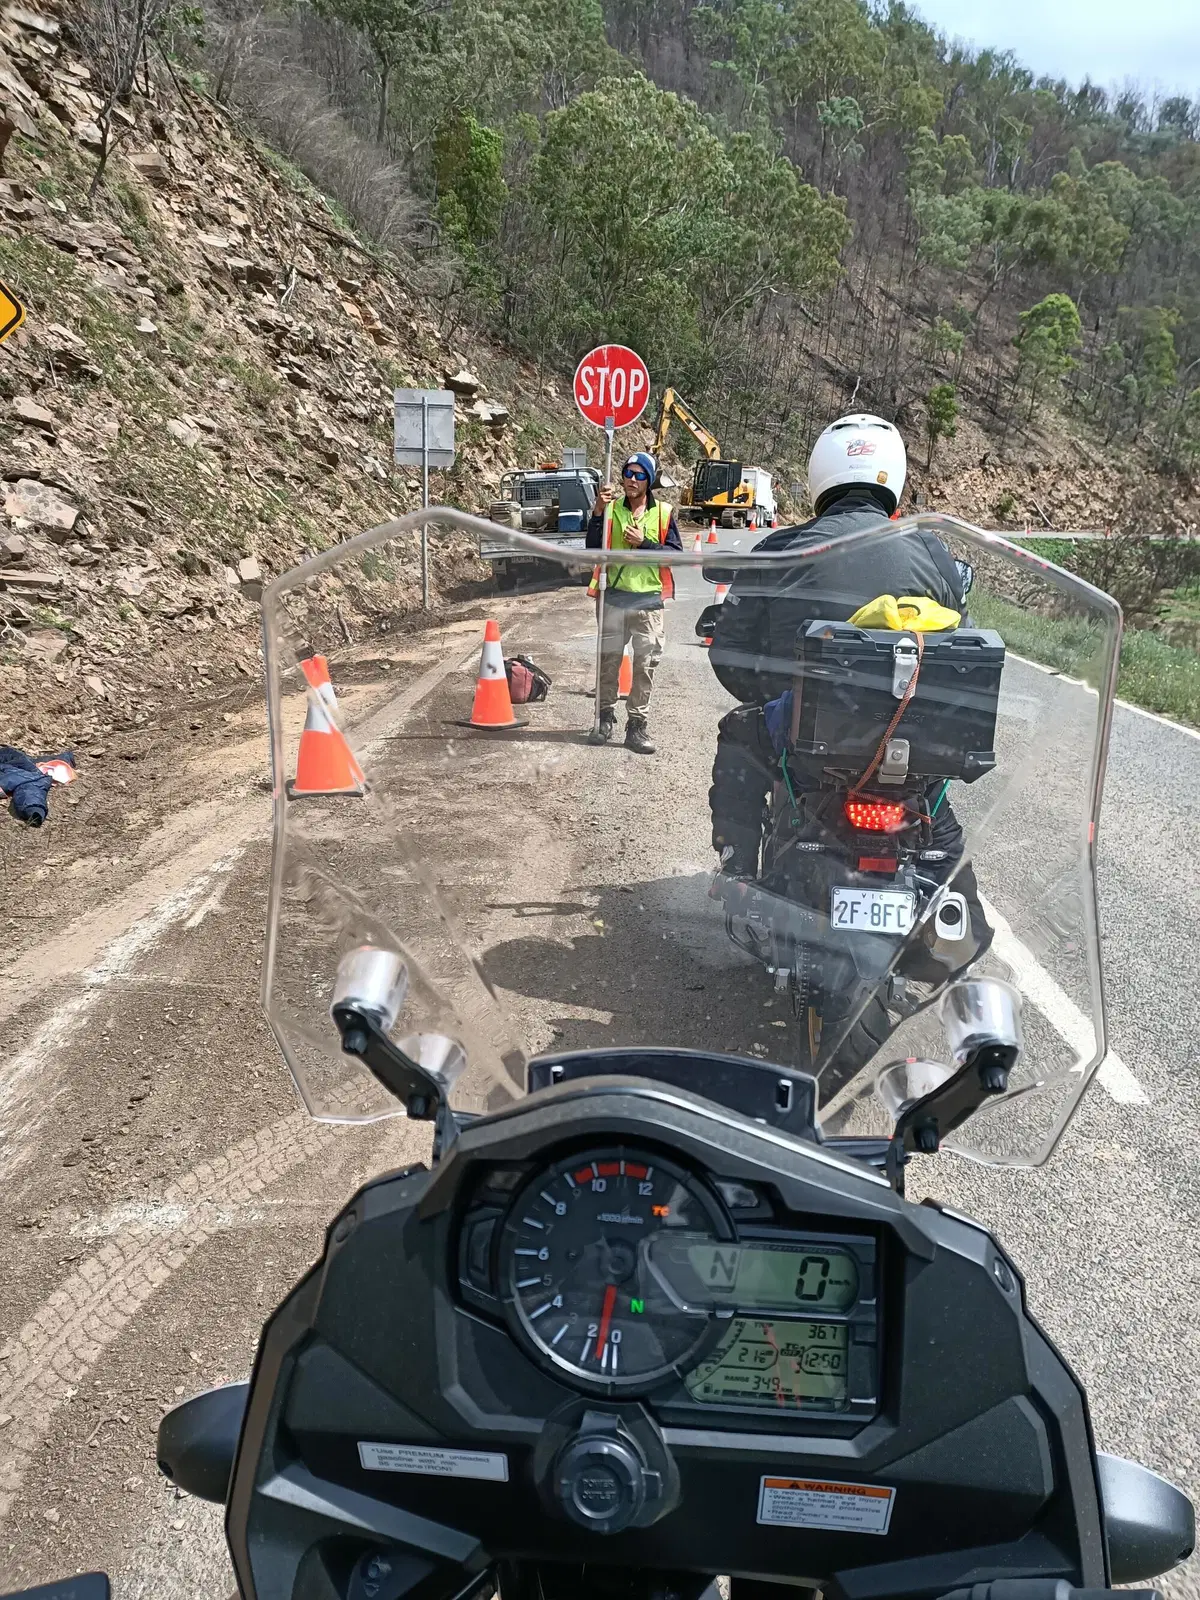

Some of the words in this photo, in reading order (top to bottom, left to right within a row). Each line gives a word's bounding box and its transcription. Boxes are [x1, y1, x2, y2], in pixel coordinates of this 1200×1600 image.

[580, 365, 645, 408] STOP
[591, 1179, 606, 1192] 10
[638, 1182, 654, 1195] 12
[555, 1201, 567, 1216] 8
[538, 1246, 550, 1261] 6
[795, 1255, 831, 1302] 0
[552, 1294, 564, 1308] 4
[630, 1298, 644, 1314] N
[587, 1322, 598, 1337] 2
[611, 1329, 622, 1344] 0
[398, 1449, 445, 1459] PREMIUM
[803, 1482, 867, 1495] WARNING
